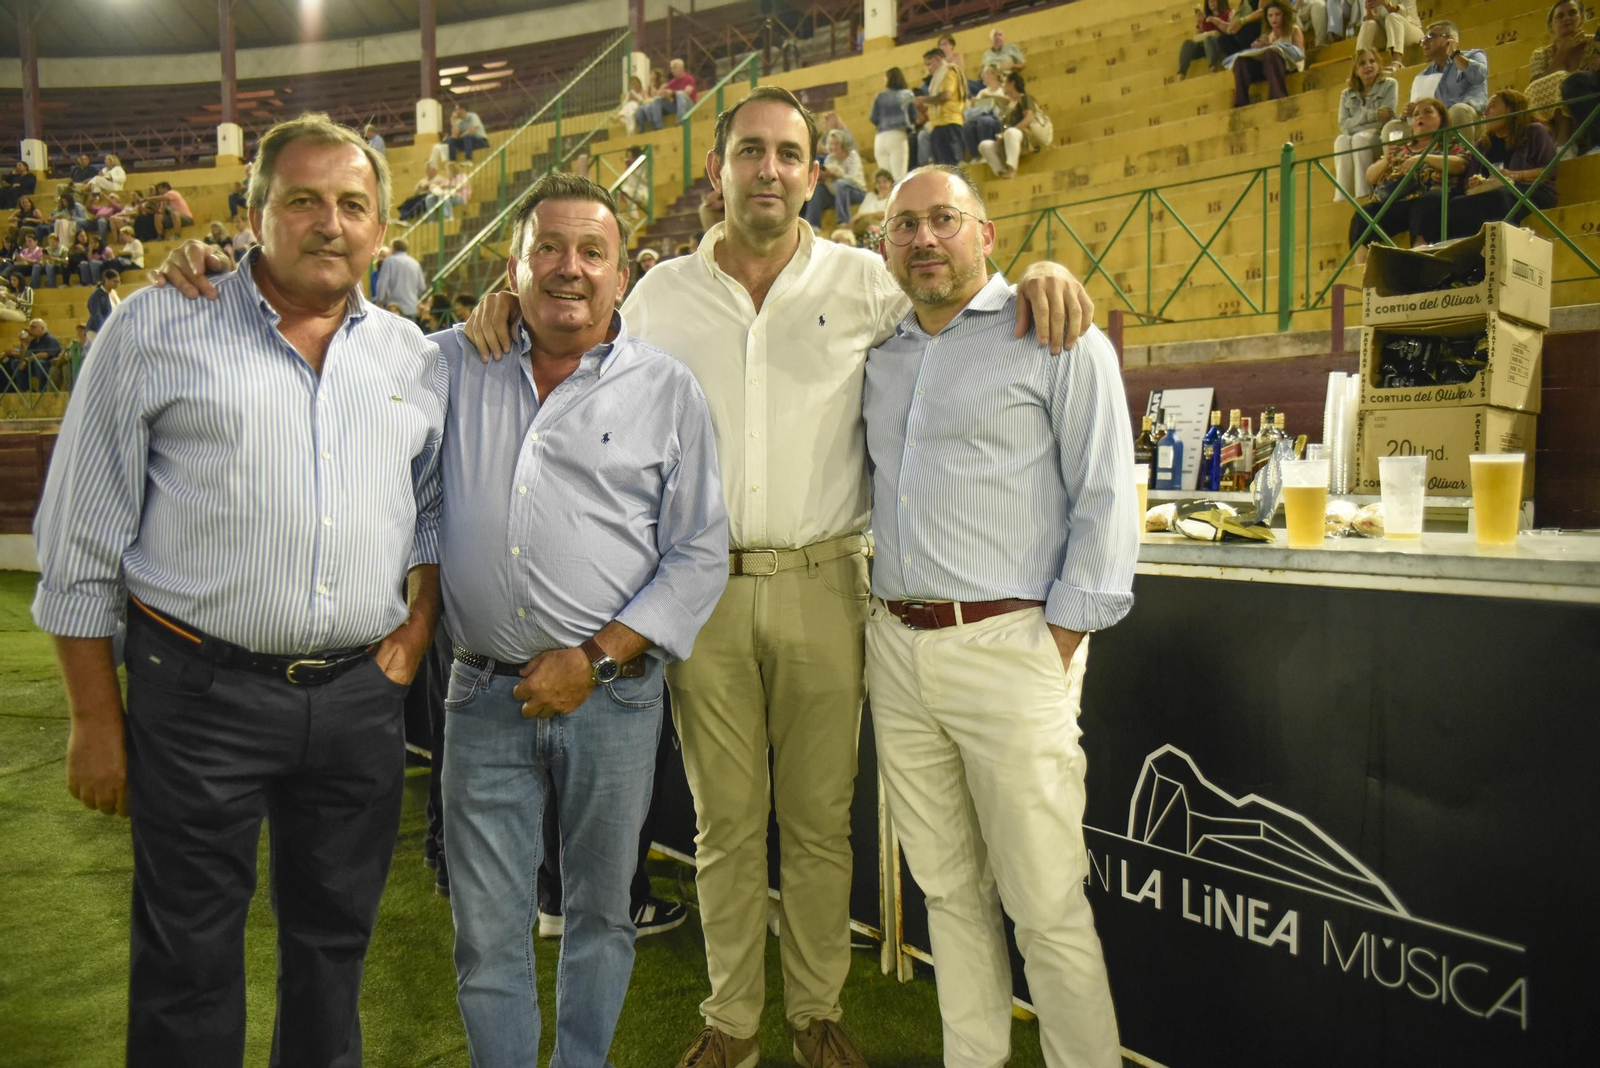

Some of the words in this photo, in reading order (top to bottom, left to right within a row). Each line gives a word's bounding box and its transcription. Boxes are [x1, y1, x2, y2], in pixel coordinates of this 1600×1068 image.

[1495, 30, 1517, 45] 22
[1289, 131, 1303, 142] 16
[1032, 184, 1042, 194] 11
[1489, 226, 1497, 266] PATATAS
[1245, 267, 1262, 281] 16
[1486, 271, 1495, 305] FRITAS
[1218, 300, 1241, 317] 22
[1375, 303, 1417, 315] CORTIJO
[1419, 297, 1439, 311] del
[1441, 293, 1482, 309] Olivar
[1370, 394, 1411, 404] CORTIJO
[1414, 389, 1432, 402] del
[1435, 388, 1475, 402] Olivar
[1474, 413, 1482, 452] PATATAS
[1428, 476, 1468, 490] Olivar
[1083, 848, 1109, 892] N
[1121, 858, 1162, 910] LA
